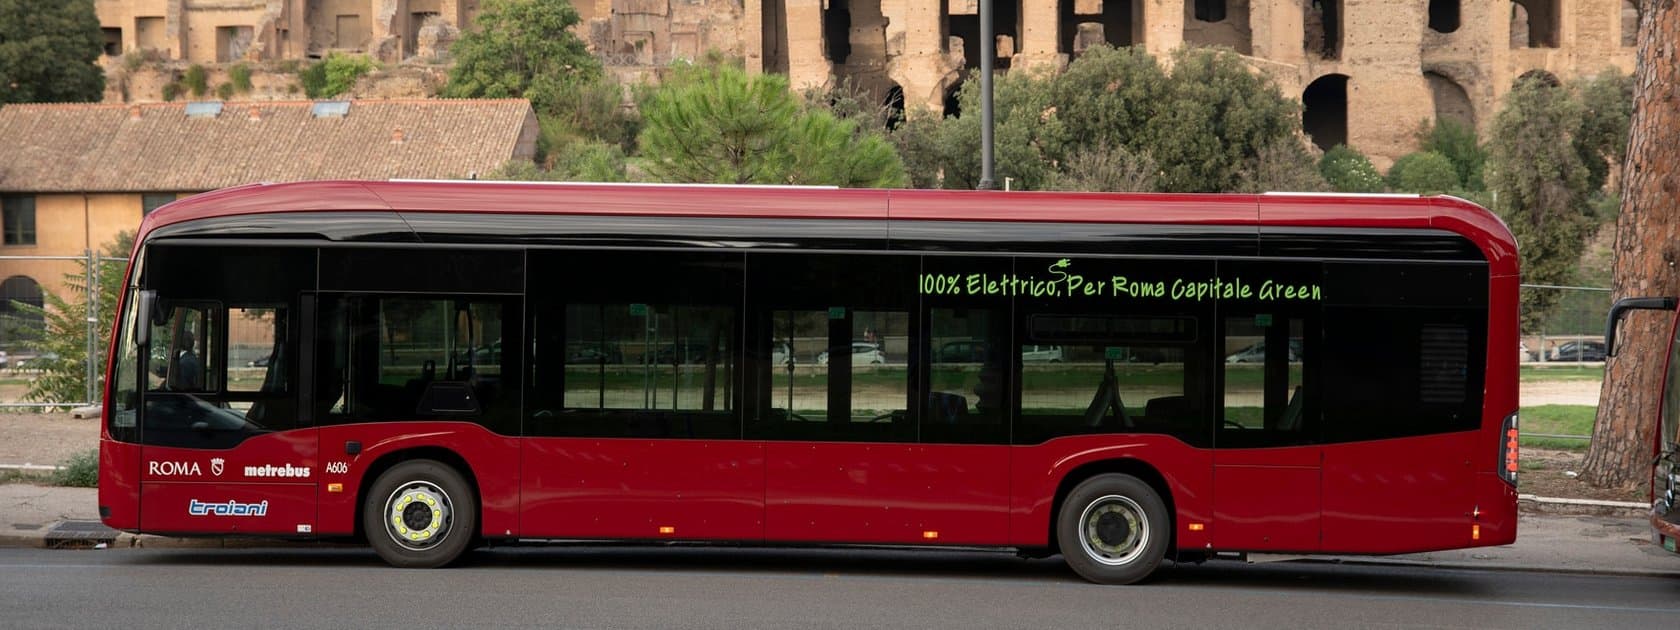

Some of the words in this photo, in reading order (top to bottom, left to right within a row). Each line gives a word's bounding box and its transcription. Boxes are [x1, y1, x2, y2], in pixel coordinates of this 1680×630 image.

[919, 273, 961, 295] 100%
[1066, 274, 1105, 297] Per
[1112, 275, 1165, 298] Roma
[1171, 277, 1253, 301] Capitale
[1258, 279, 1322, 301] Green
[149, 461, 202, 475] ROMA
[244, 463, 310, 477] metrebus
[326, 461, 348, 474] A606
[189, 499, 268, 516] troiani
